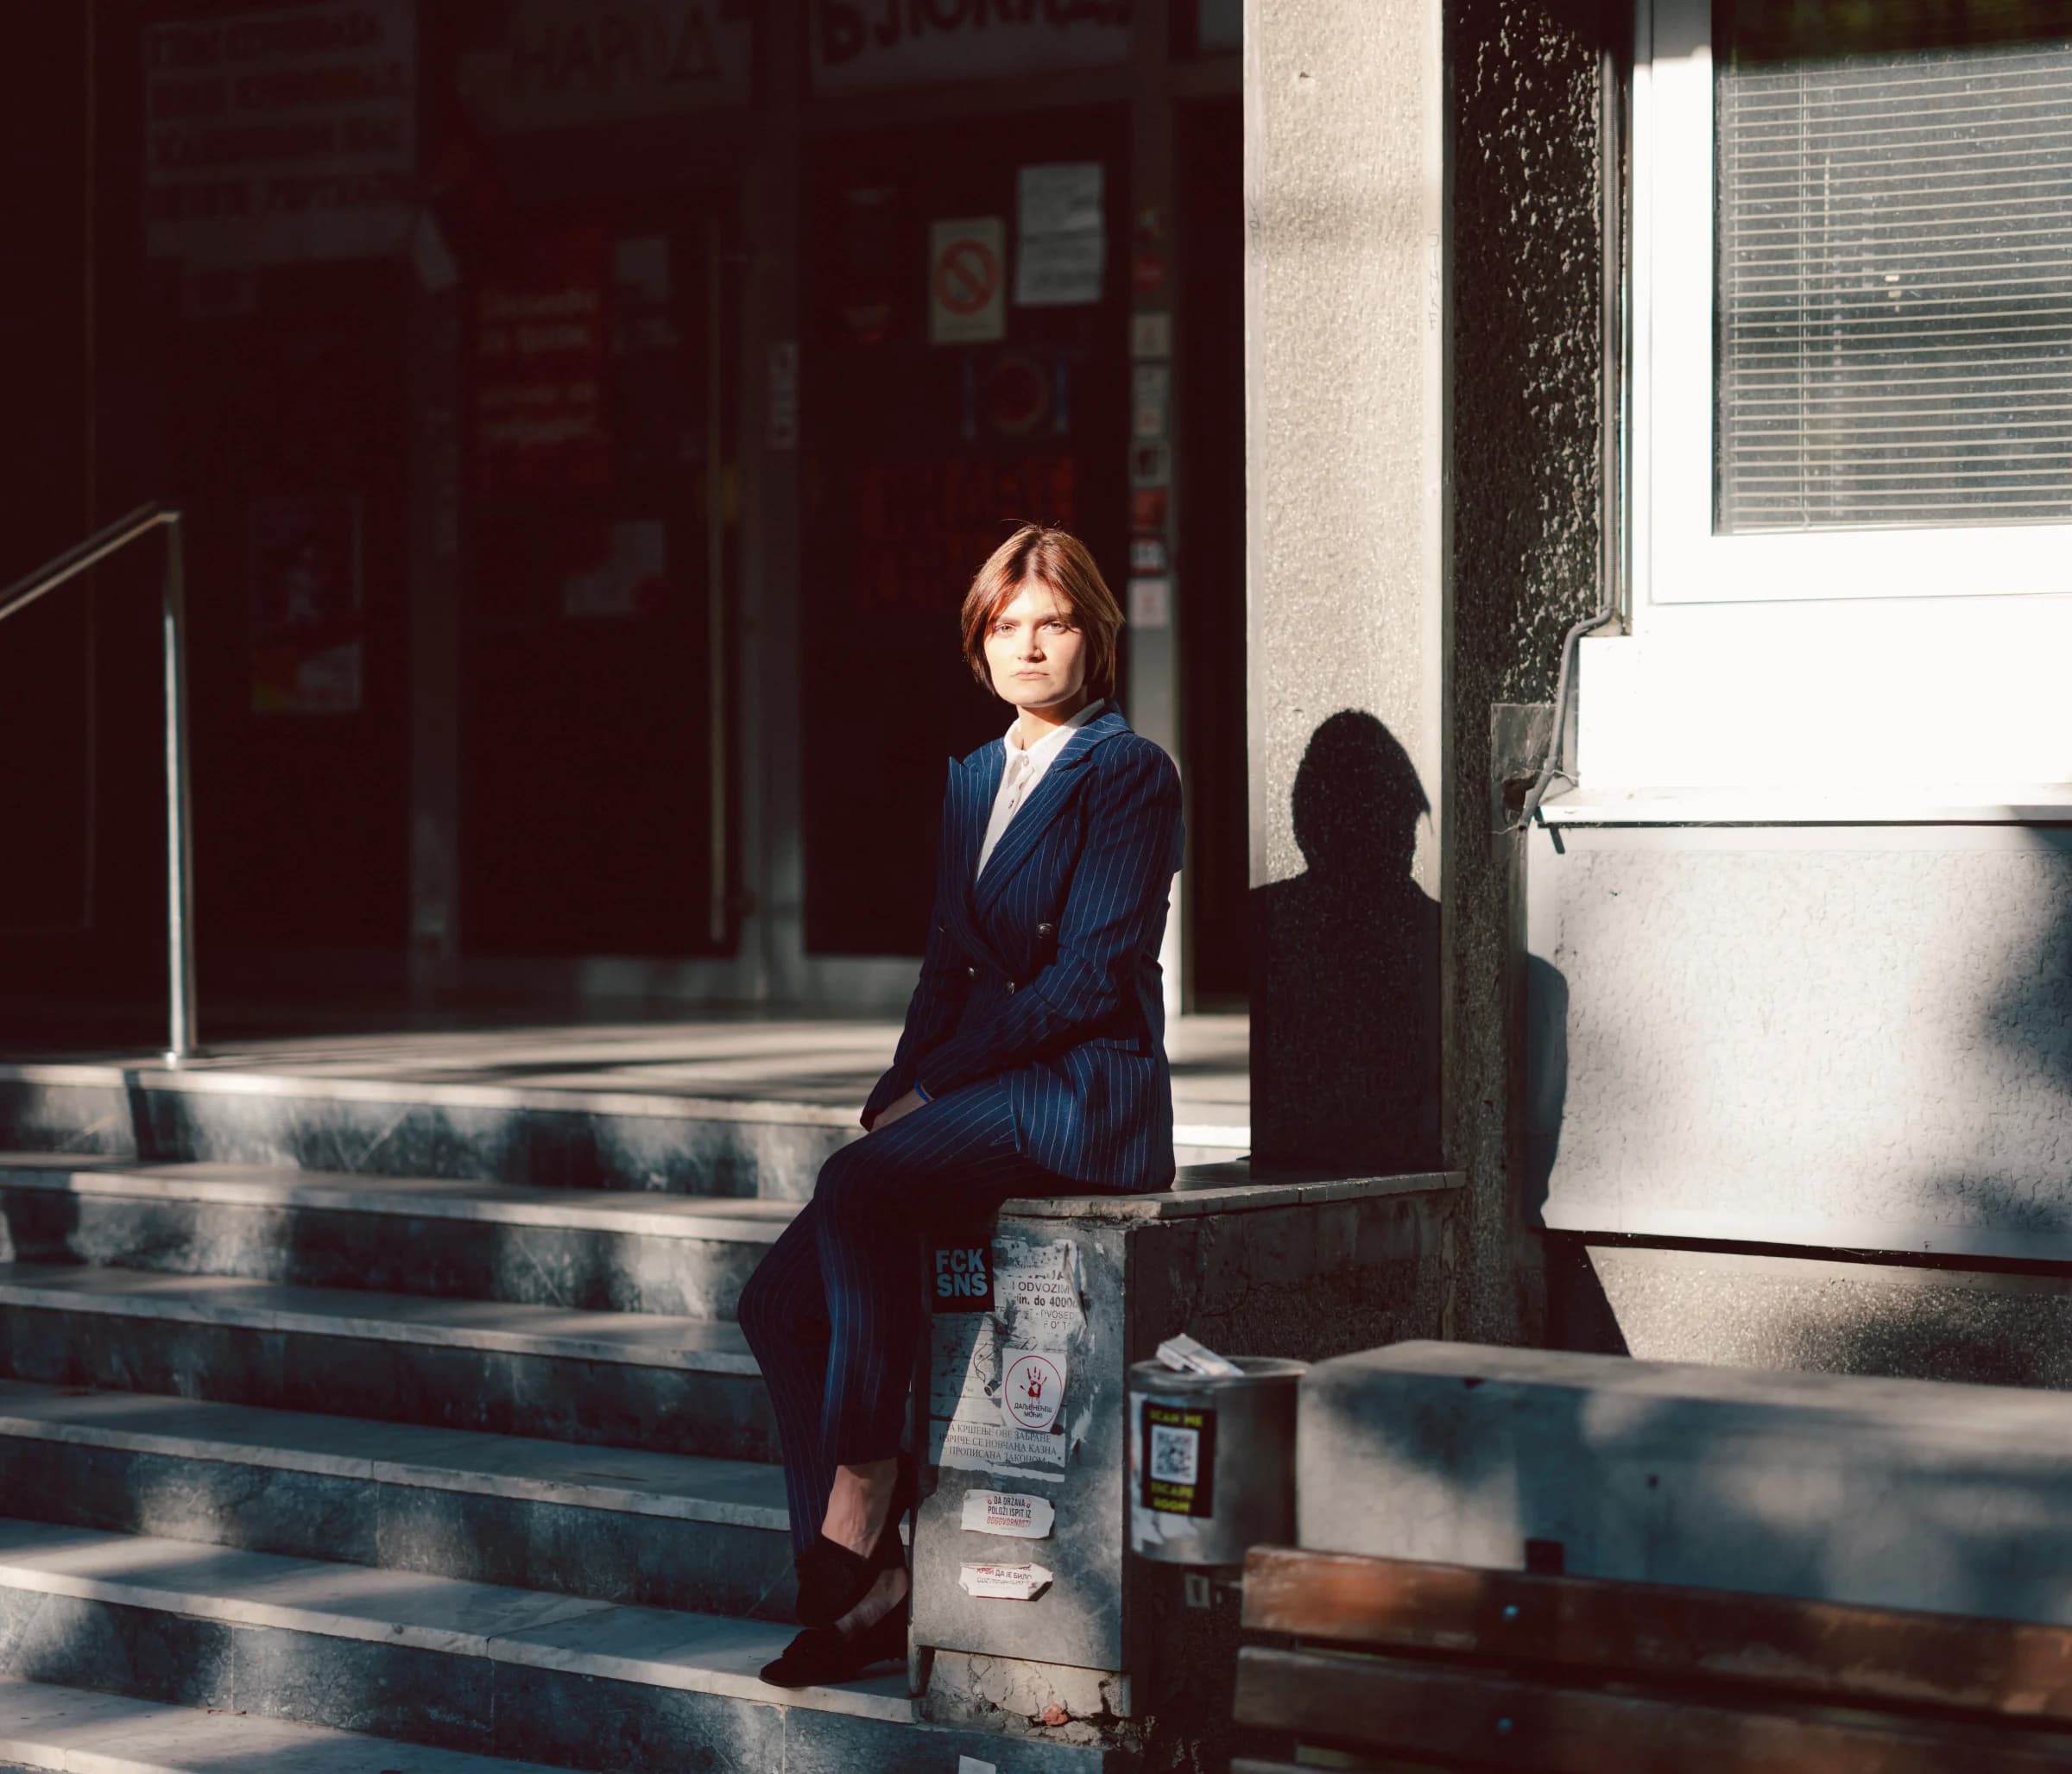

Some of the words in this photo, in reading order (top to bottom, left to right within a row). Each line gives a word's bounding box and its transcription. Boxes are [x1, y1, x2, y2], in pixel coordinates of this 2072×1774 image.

[935, 1248, 986, 1272] FCK
[937, 1273, 988, 1297] SNS
[1018, 1281, 1070, 1294] ODVOZIM
[1034, 1295, 1045, 1306] do
[957, 1424, 992, 1436] КРШЕЊЕ
[1014, 1430, 1051, 1443] ЗАБРАНЕ
[972, 1436, 983, 1446] СЕ
[985, 1438, 1027, 1452] НОВЧАНА
[1028, 1443, 1057, 1455] КАЗНА
[950, 1446, 1001, 1459] ПРОПИСАНА
[994, 1496, 1001, 1505] DA
[1010, 1508, 1024, 1517] ISPIT
[1026, 1509, 1032, 1518] IZ
